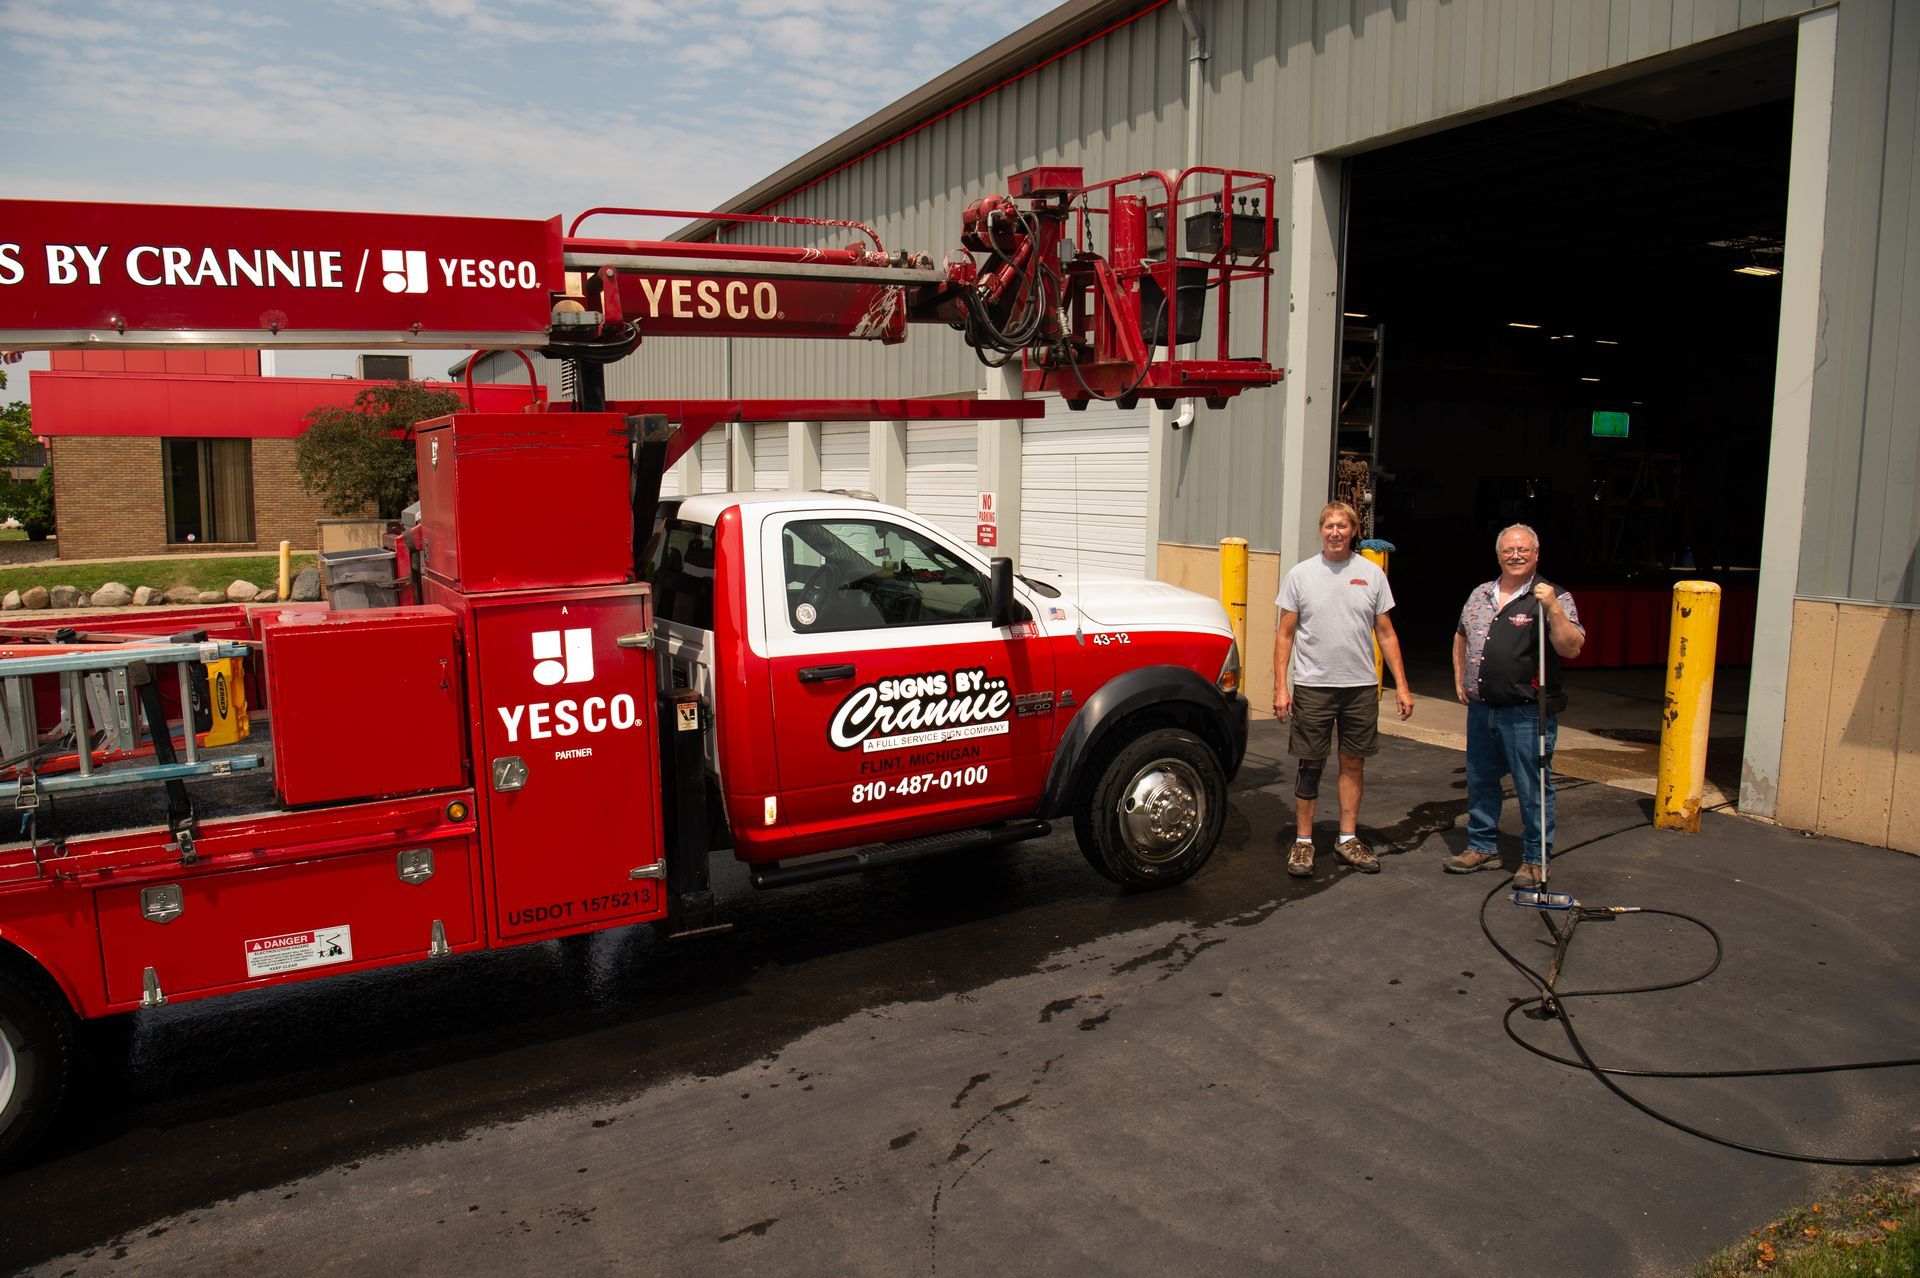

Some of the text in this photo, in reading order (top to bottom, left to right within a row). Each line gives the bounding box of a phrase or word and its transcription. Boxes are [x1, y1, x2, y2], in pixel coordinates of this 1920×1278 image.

[45, 244, 109, 285] BY
[125, 245, 343, 288] CRANNIE
[982, 494, 992, 510] NO
[979, 511, 995, 523] PARKING
[561, 605, 569, 615] A
[1093, 632, 1131, 646] 43-12
[879, 674, 948, 702] SIGNS
[1018, 703, 1051, 713] 500
[830, 686, 1012, 748] Crannie
[867, 723, 1006, 750] A FULL SERVICE SIGN COMPANY
[555, 747, 593, 761] PARTNER
[909, 746, 981, 767] MICHIGAN
[508, 889, 651, 926] USDOT 1575213
[263, 935, 308, 949] DANGER
